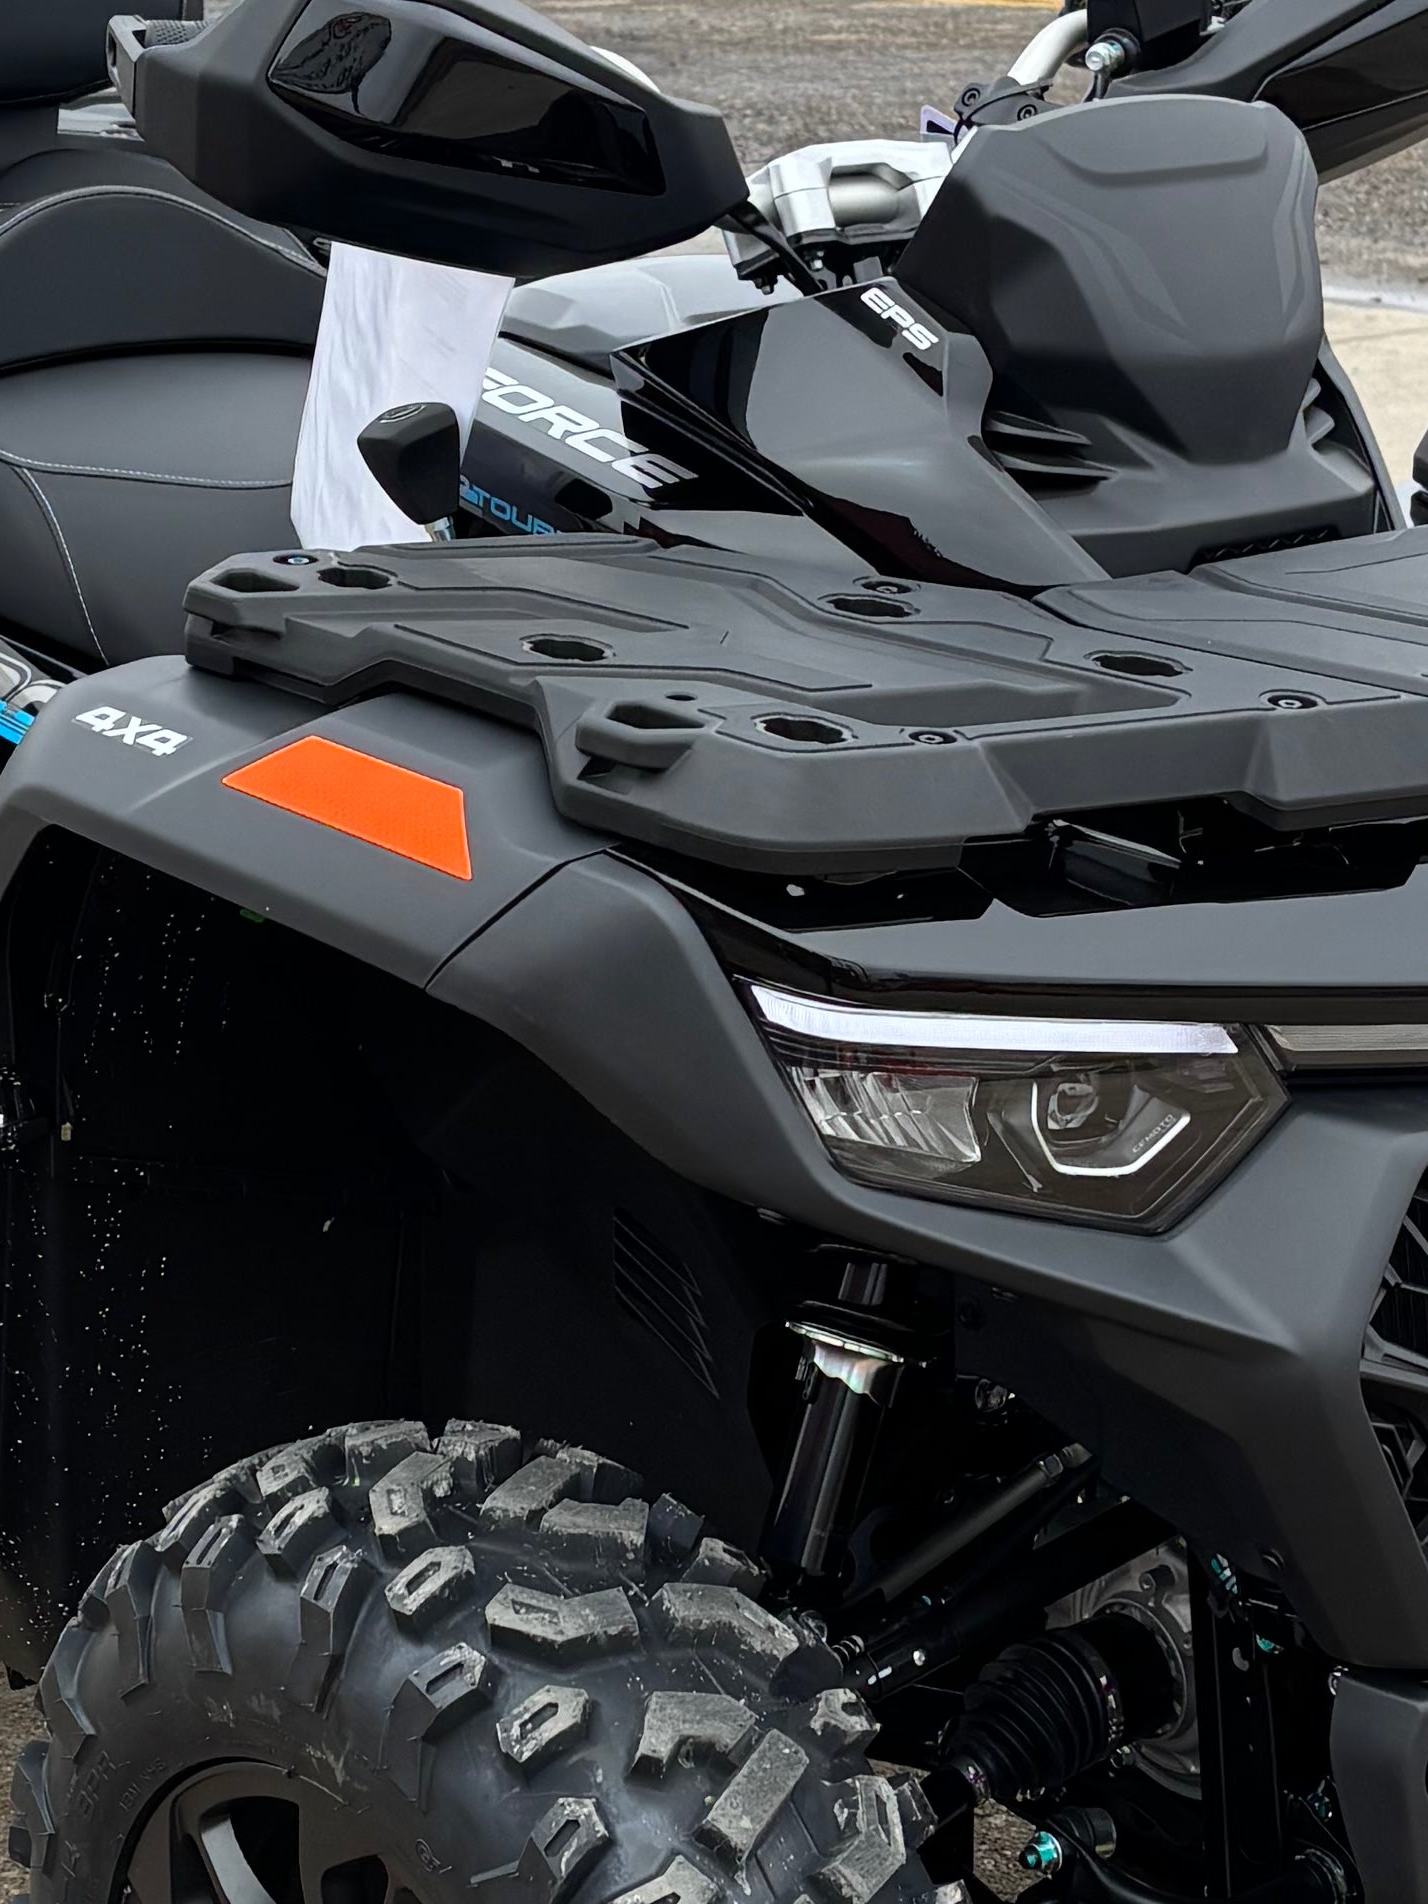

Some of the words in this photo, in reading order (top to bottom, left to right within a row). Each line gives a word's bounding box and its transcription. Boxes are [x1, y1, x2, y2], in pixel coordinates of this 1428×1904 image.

[860, 287, 939, 350] EPS
[471, 483, 562, 535] TOUR
[74, 705, 189, 757] 4X4
